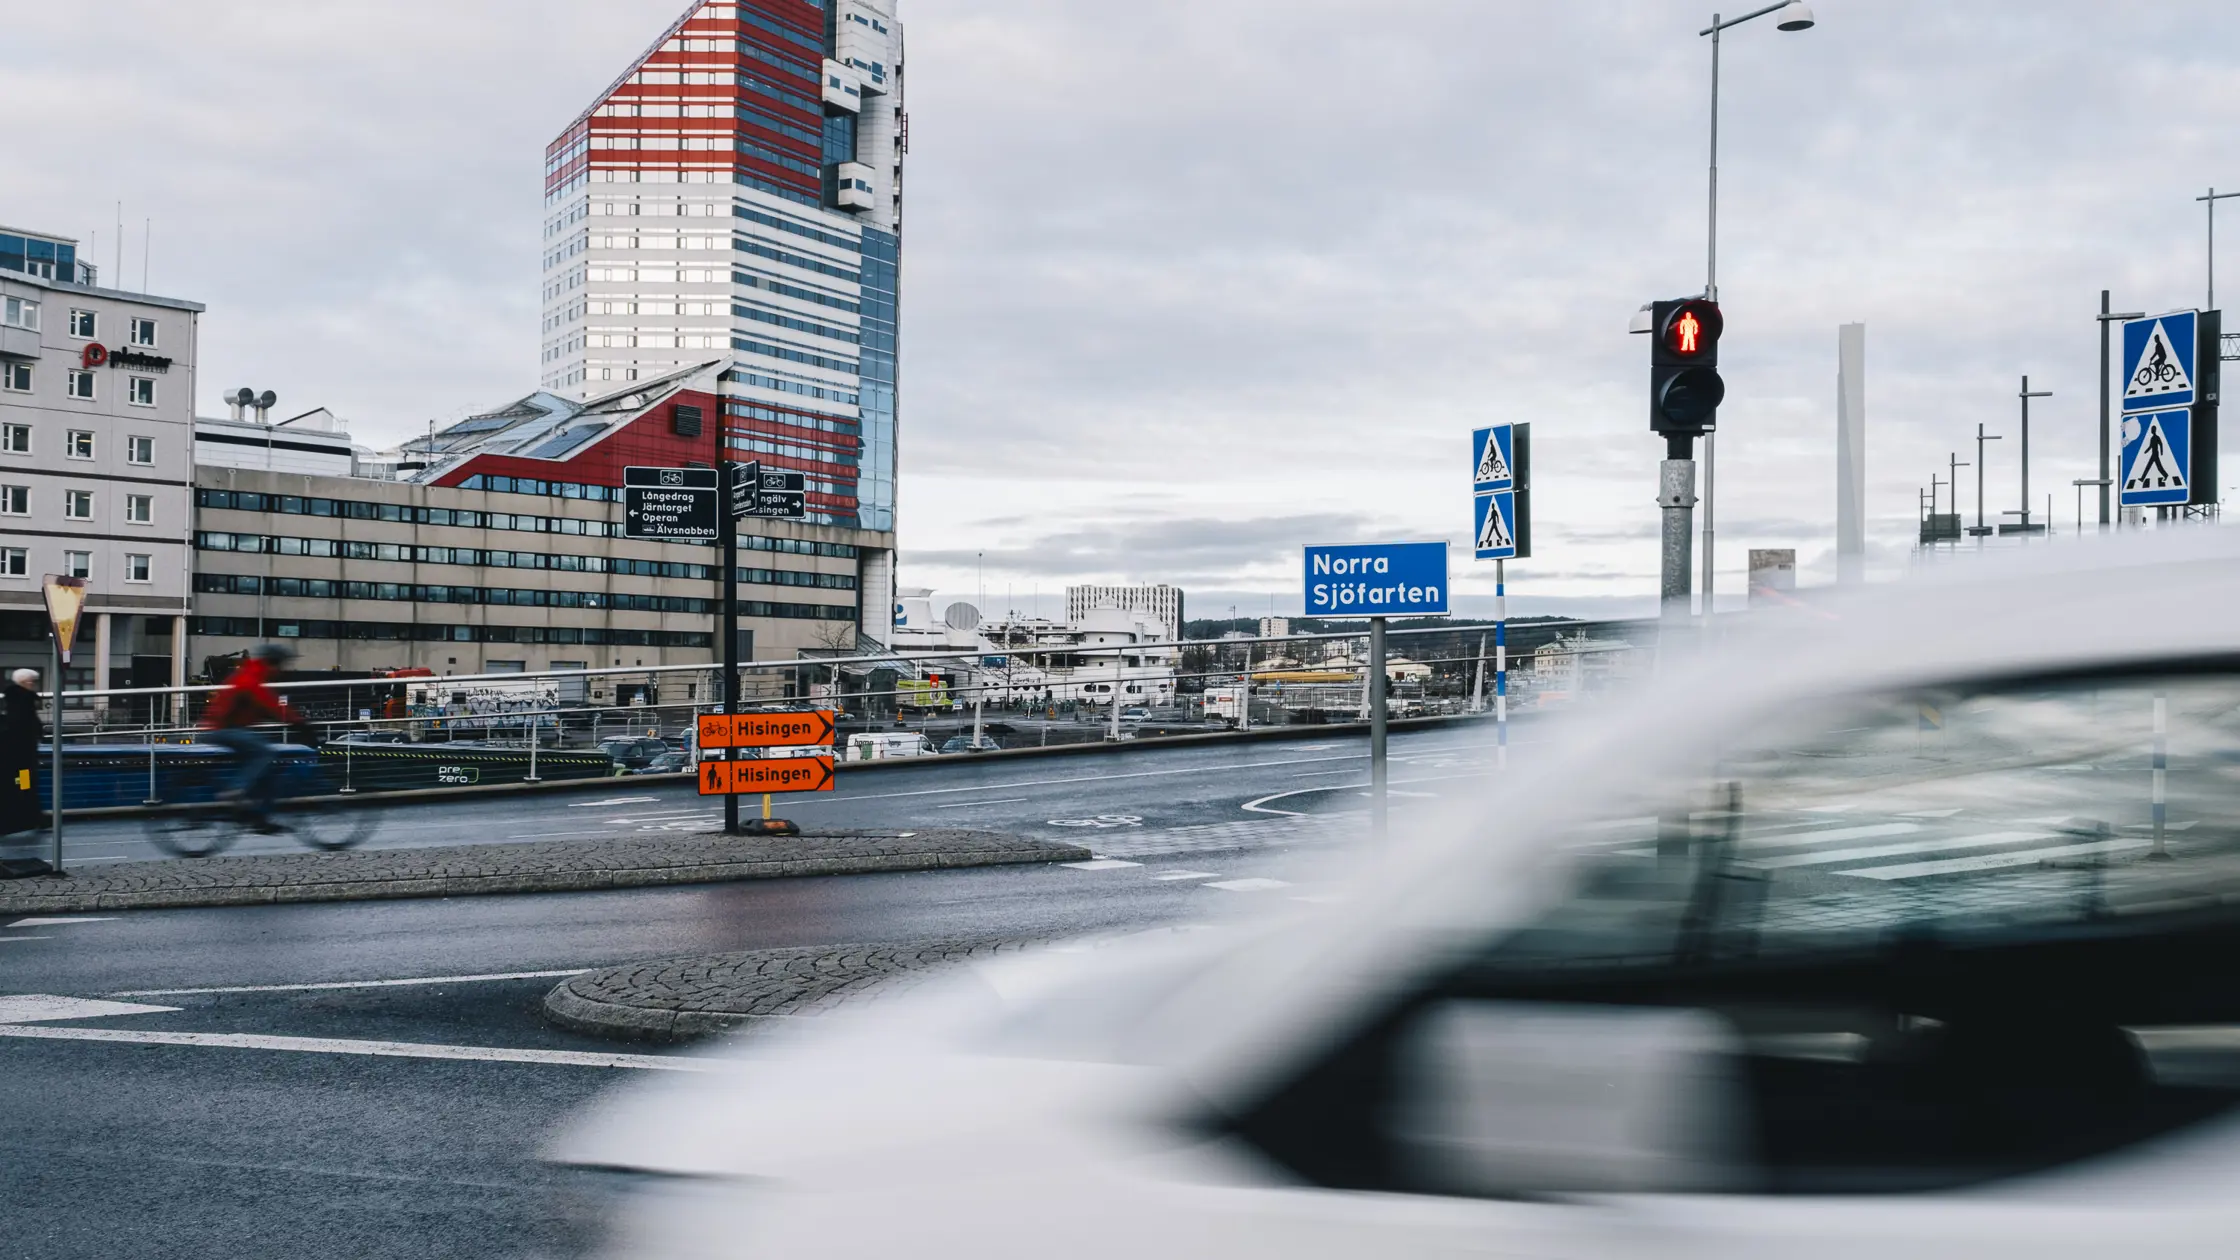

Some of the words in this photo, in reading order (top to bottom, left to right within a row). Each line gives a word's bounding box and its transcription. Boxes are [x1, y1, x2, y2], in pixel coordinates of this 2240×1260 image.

[642, 491, 694, 503] Långedrag
[760, 494, 787, 504] ngälv
[642, 502, 692, 514] Järntorget
[752, 505, 789, 516] singen
[642, 513, 678, 523] Operan
[656, 523, 715, 535] Älvsnabben
[1313, 553, 1389, 575] Norra
[1313, 582, 1439, 610] Sjöfarten
[738, 720, 811, 738] Hisingen
[438, 766, 461, 774] pre
[738, 767, 811, 784] Hisingen
[438, 775, 468, 783] zero
